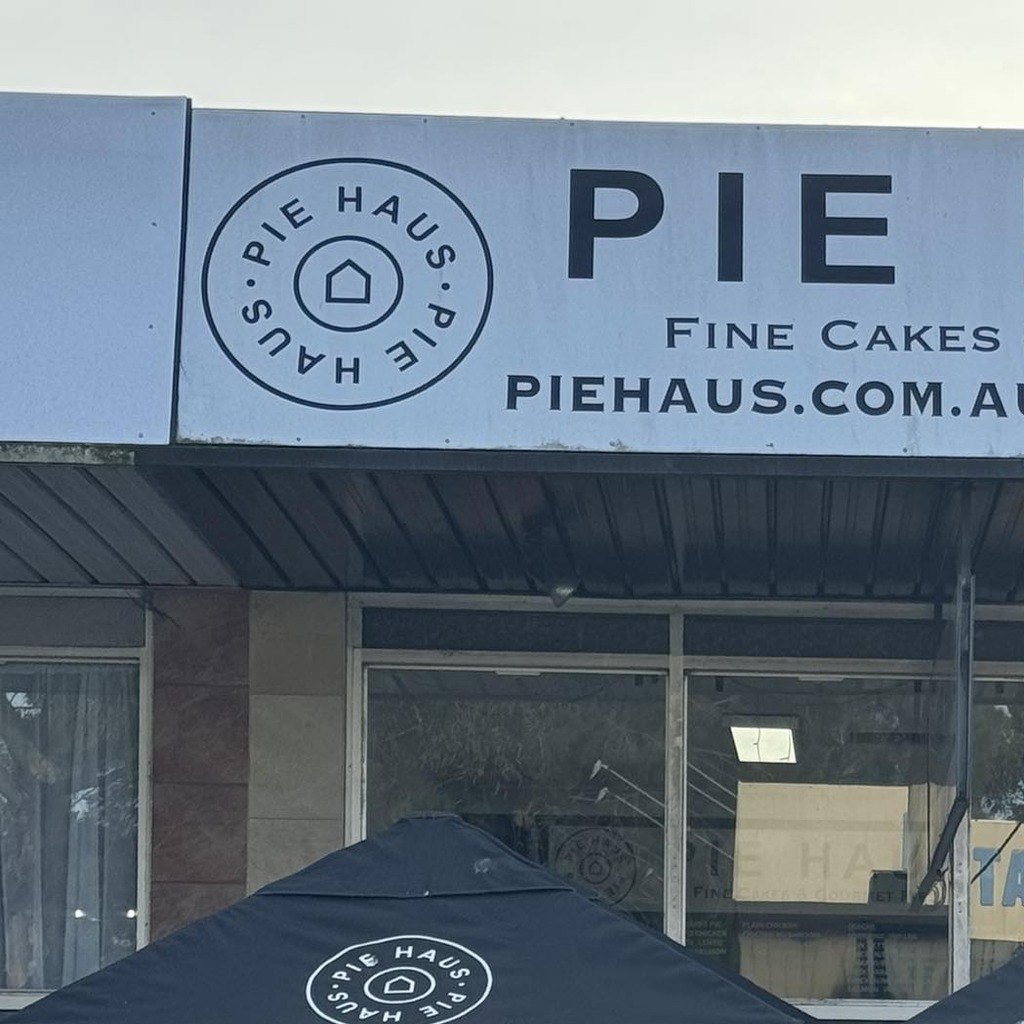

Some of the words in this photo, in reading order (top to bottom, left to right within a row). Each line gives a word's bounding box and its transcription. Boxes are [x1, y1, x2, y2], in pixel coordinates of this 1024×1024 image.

[241, 198, 314, 266] PIE
[338, 186, 456, 270] HAUS
[568, 169, 896, 285] PIE
[241, 300, 360, 384] HAUS
[385, 303, 456, 372] PIE
[332, 953, 379, 981] PIE
[395, 946, 470, 979] HAUS
[328, 992, 402, 1022] HAUS
[419, 992, 467, 1018] PIE
